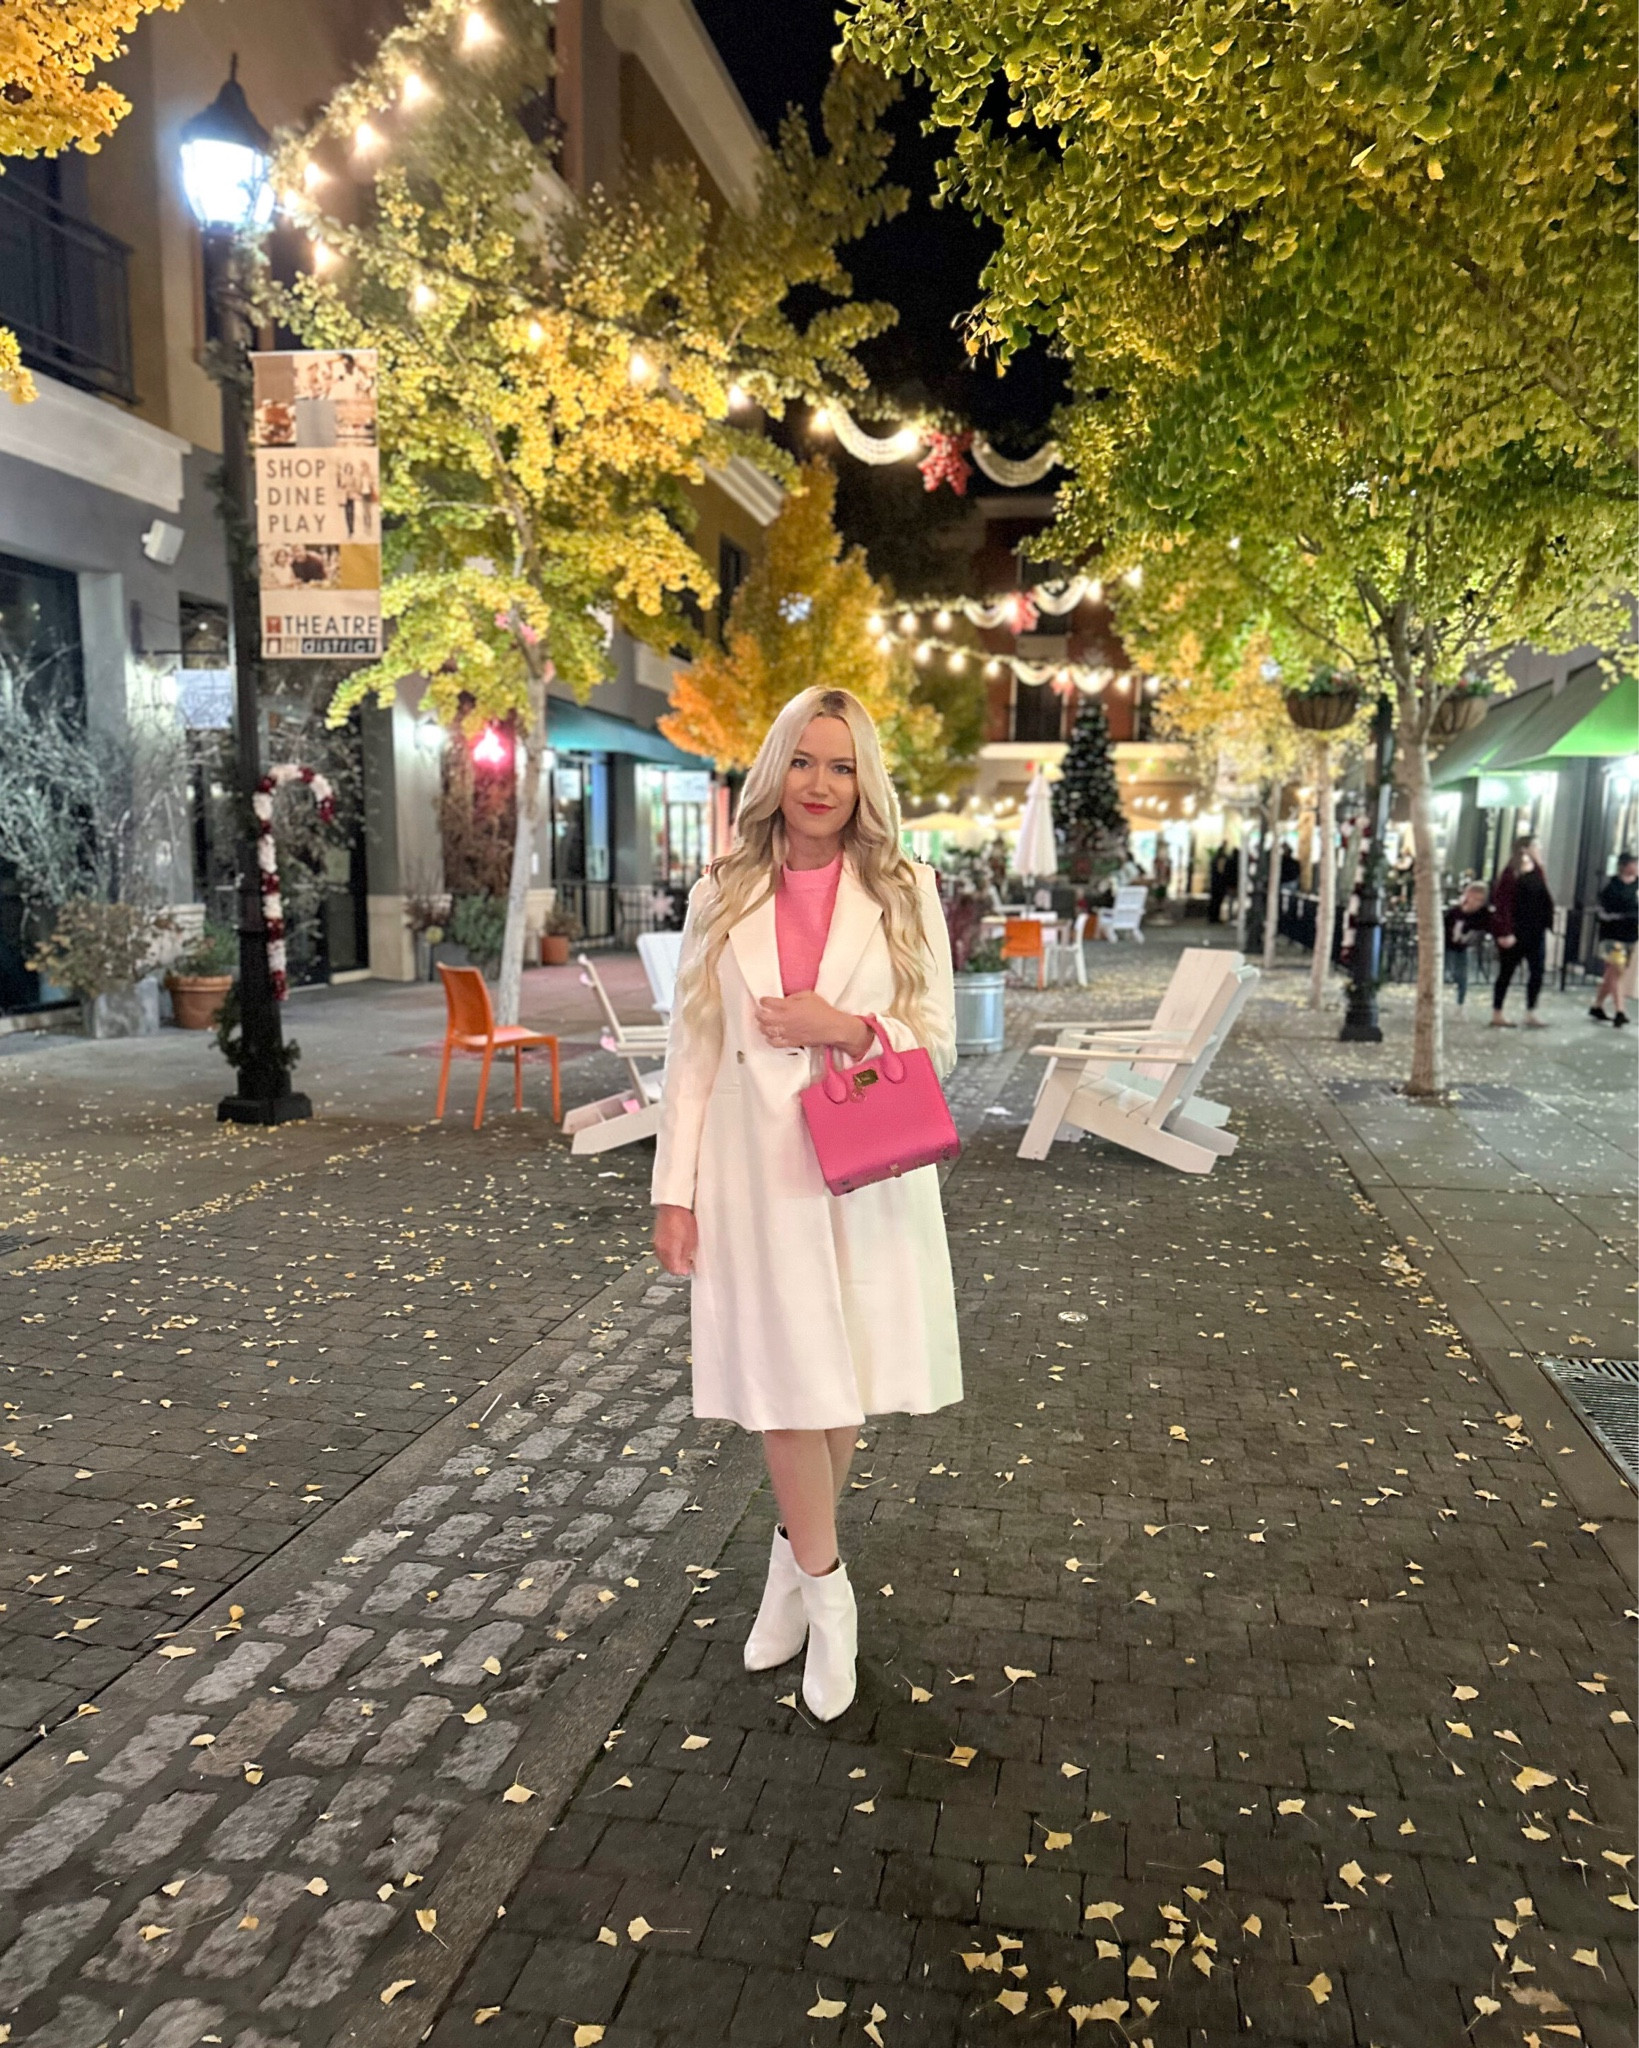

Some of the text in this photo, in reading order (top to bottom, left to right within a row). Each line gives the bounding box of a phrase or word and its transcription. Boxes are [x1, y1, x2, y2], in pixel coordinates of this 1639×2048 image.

[266, 459, 326, 479] SHOP
[268, 487, 326, 506] DINE
[268, 514, 326, 533] PLAY
[284, 615, 378, 634] THEATRE
[303, 638, 376, 653] district
